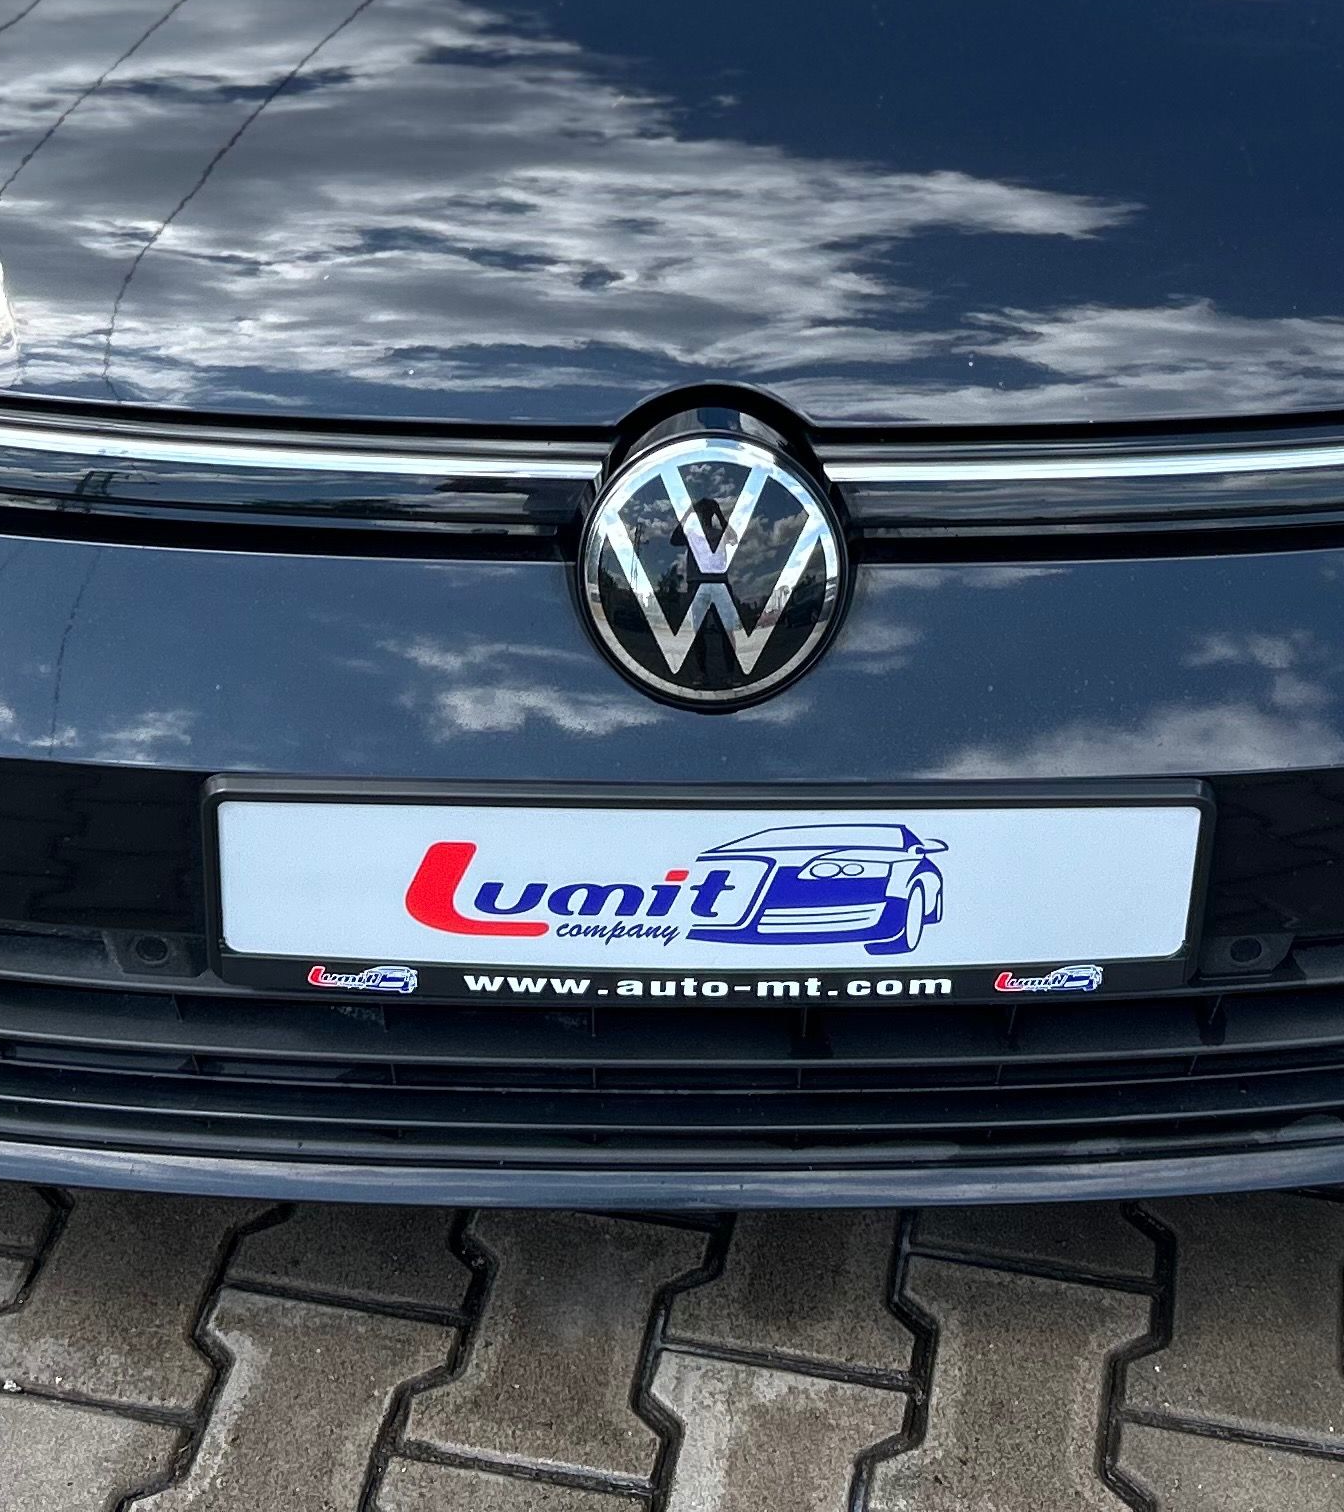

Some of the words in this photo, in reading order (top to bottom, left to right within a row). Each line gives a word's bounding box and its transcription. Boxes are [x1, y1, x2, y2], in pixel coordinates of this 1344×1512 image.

[405, 840, 736, 937] Lumit
[556, 920, 681, 946] company
[462, 974, 953, 998] www.auto-mt.com
